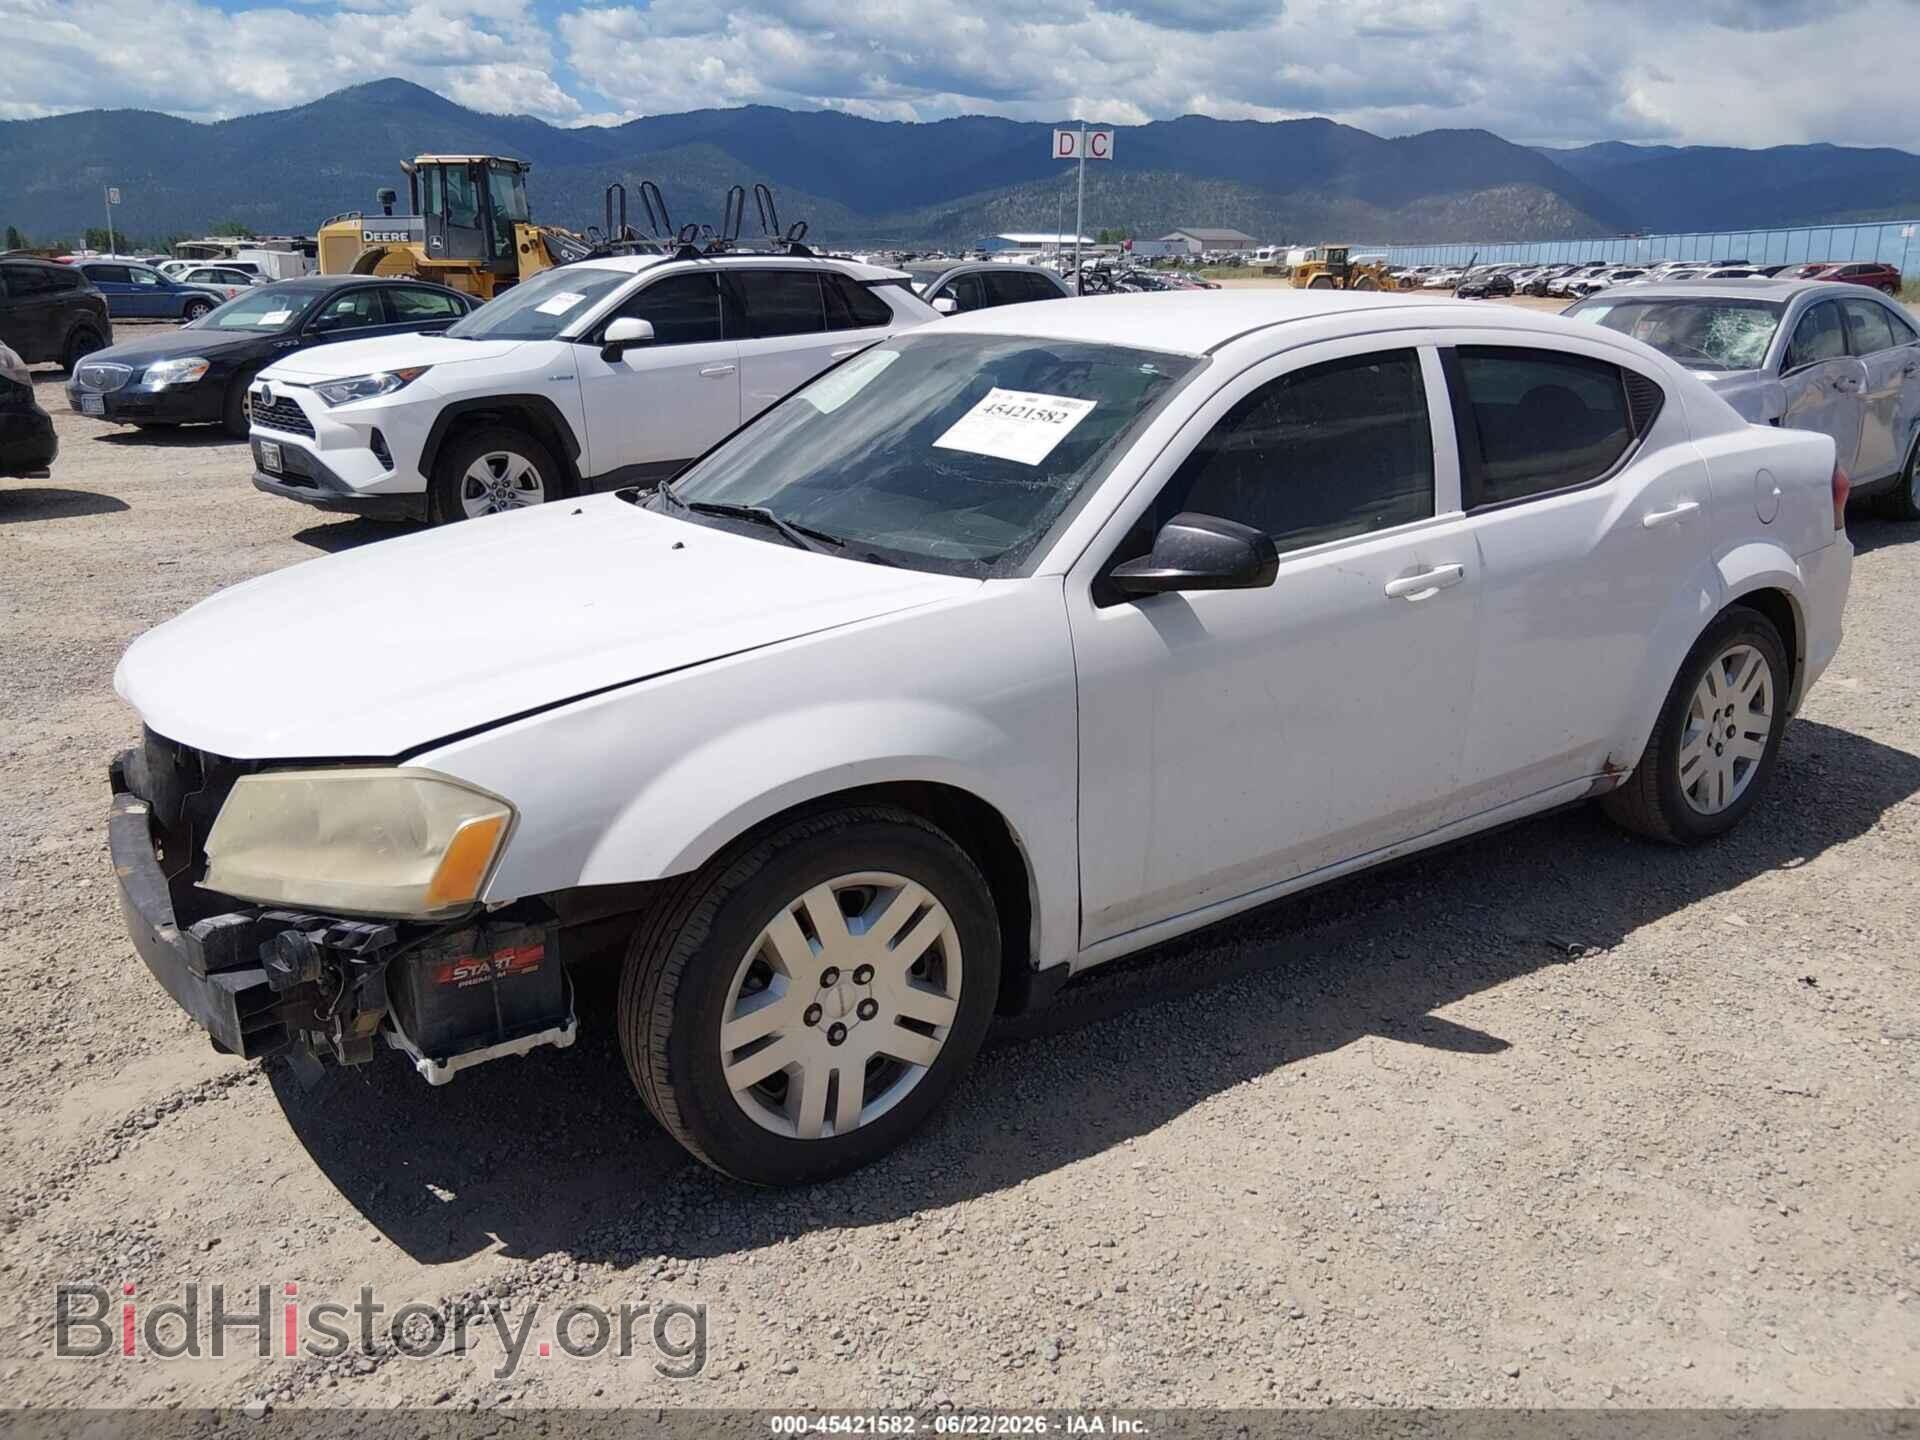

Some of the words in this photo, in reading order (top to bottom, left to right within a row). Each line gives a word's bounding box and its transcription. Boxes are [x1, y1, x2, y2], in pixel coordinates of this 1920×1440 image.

[1060, 133, 1074, 155] D
[1092, 133, 1107, 156] C
[363, 231, 408, 242] DEERE
[983, 403, 1068, 424] 45421582
